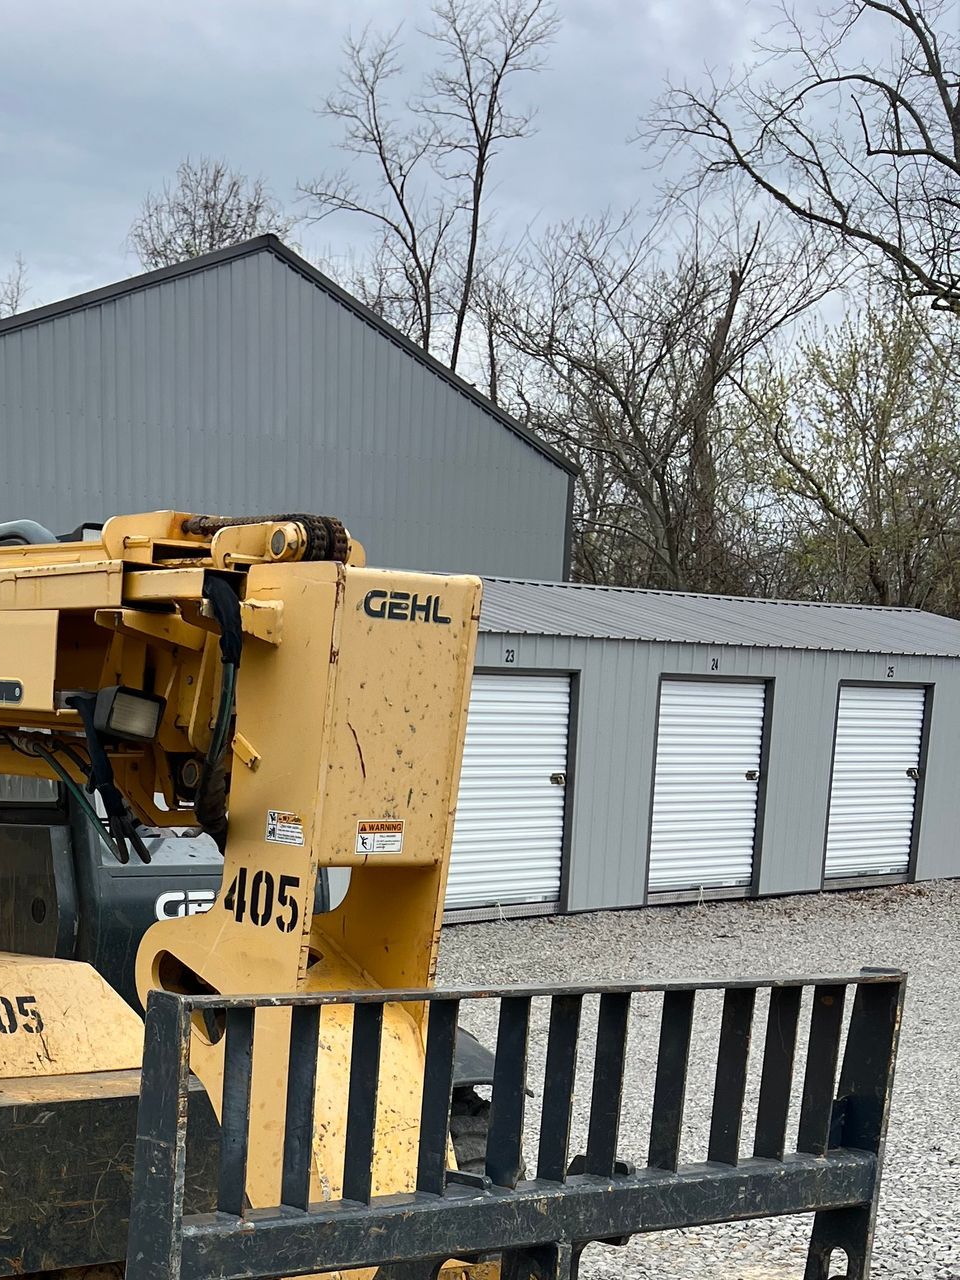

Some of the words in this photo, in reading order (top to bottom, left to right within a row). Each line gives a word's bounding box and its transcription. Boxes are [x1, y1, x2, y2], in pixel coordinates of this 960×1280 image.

[363, 589, 452, 625] GEHL
[505, 649, 515, 663] 23
[711, 658, 719, 670] 24
[886, 666, 895, 678] 25
[368, 823, 402, 832] WARNING
[224, 867, 300, 933] 405
